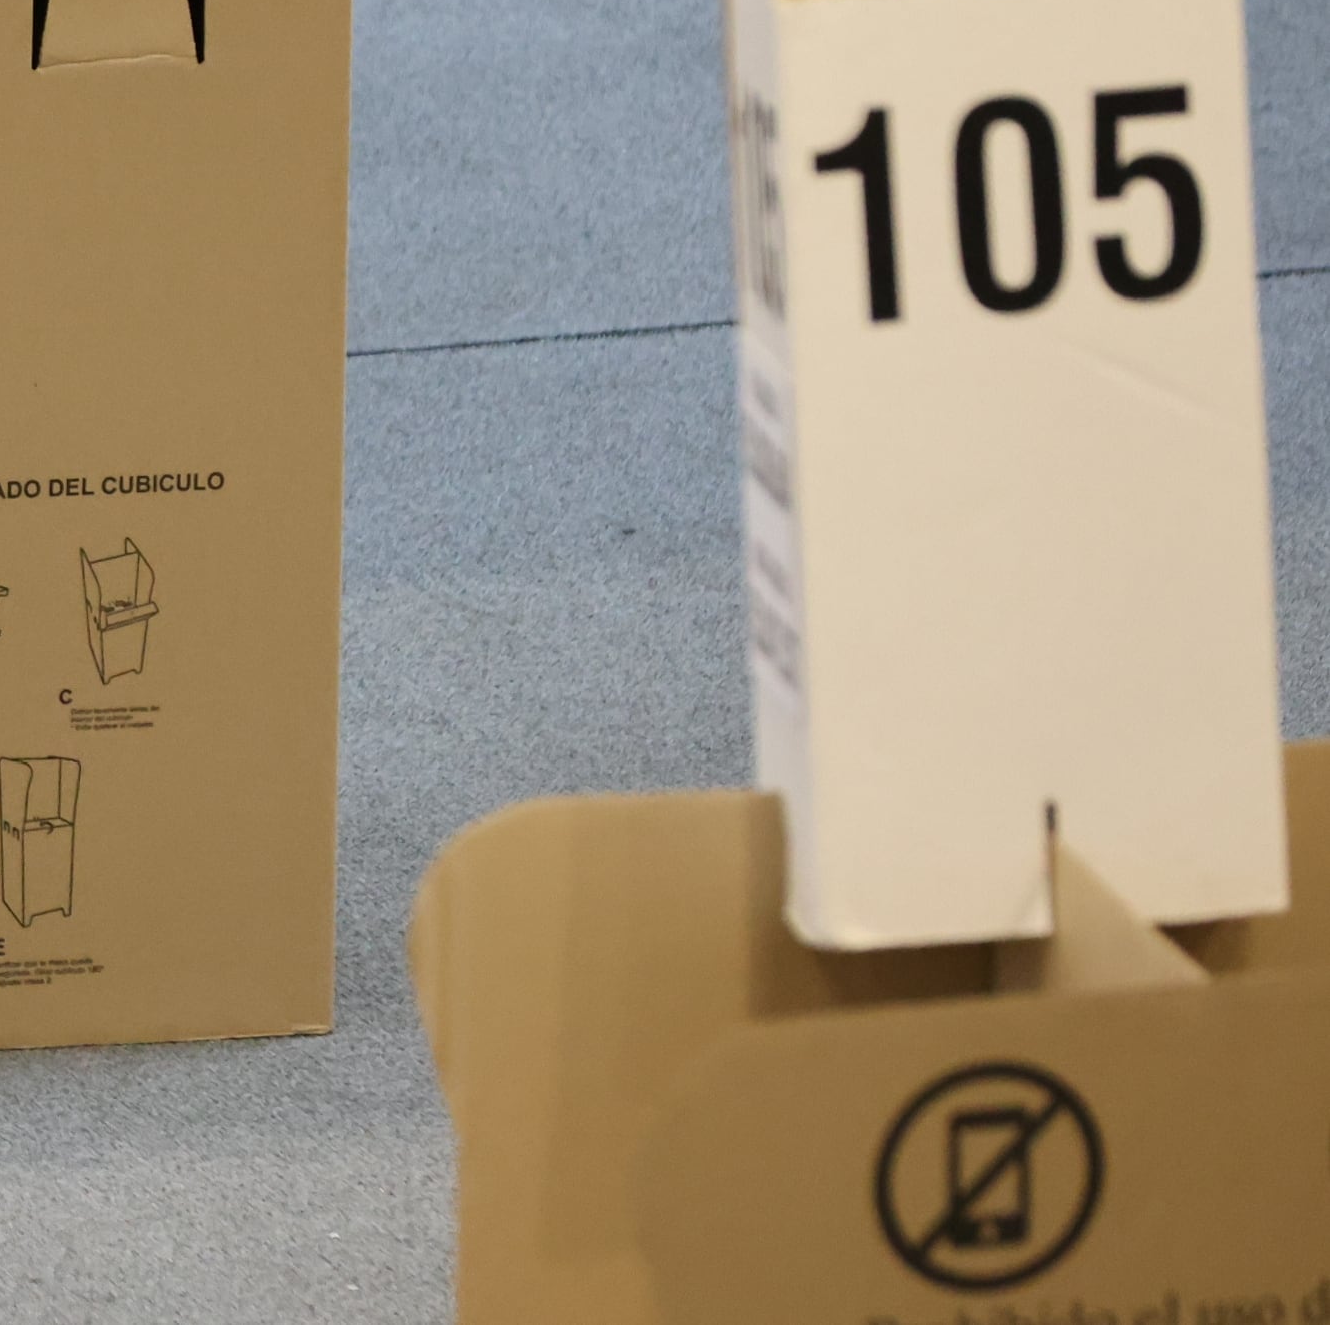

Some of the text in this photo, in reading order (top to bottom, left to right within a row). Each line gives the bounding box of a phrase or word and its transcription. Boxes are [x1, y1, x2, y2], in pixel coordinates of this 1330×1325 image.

[812, 84, 1206, 323] 105
[47, 476, 96, 498] DEL
[100, 471, 226, 496] CUBICULO
[59, 688, 73, 705] C
